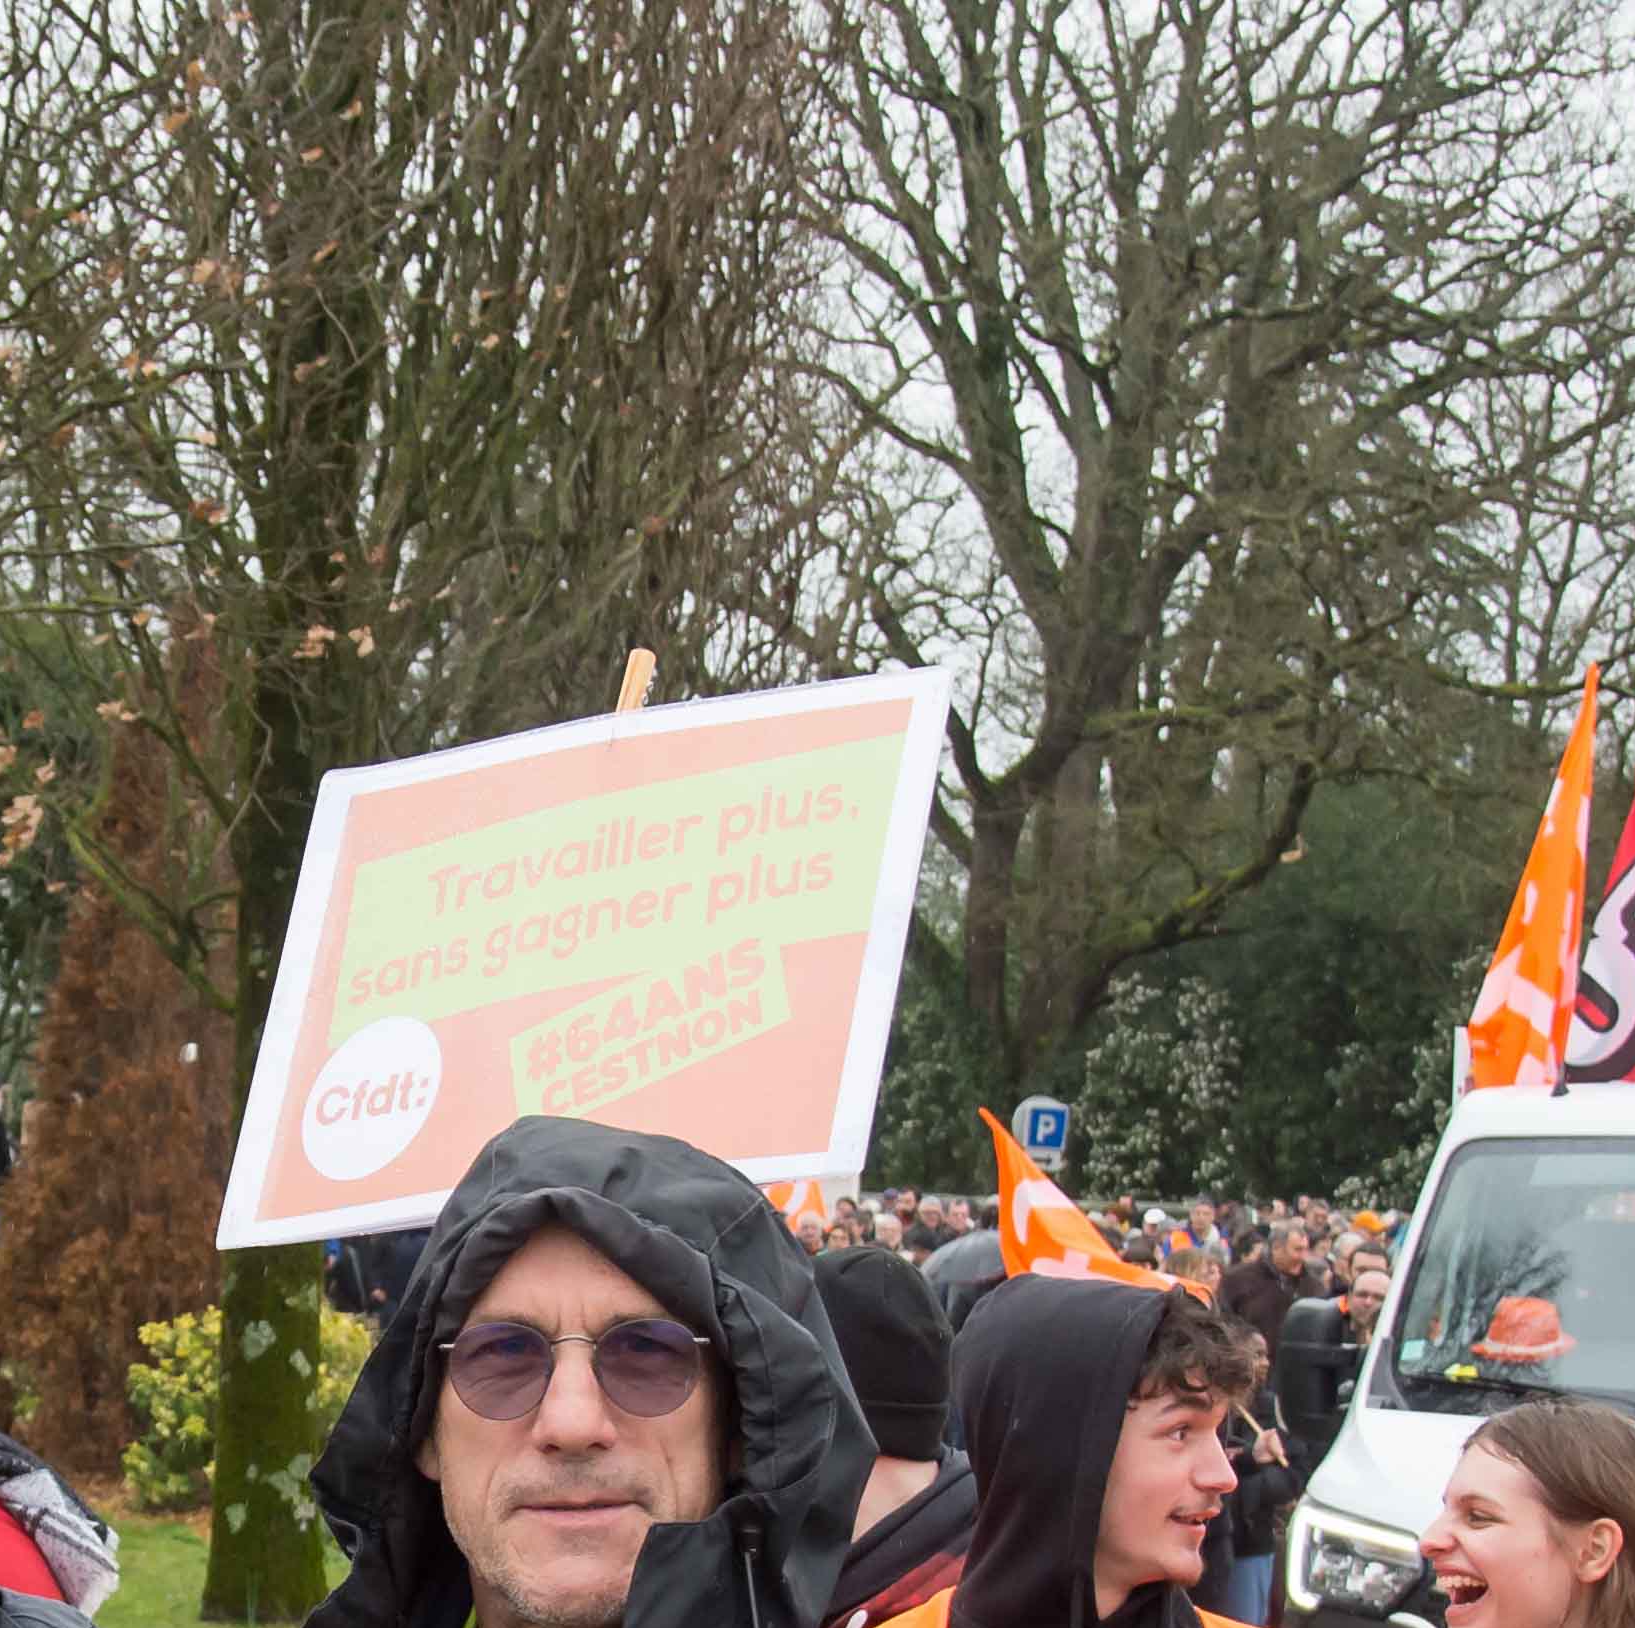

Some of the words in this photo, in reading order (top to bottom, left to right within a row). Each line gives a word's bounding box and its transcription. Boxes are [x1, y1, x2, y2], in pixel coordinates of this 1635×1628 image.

[427, 814, 704, 917] Travailler
[347, 937, 470, 1006] sans
[481, 880, 694, 977] gagner
[706, 852, 835, 926] plus
[526, 938, 767, 1081] #64ANS
[541, 989, 764, 1117] CESTNON
[315, 1074, 429, 1127] Cfdt:
[1036, 1113, 1056, 1143] P
